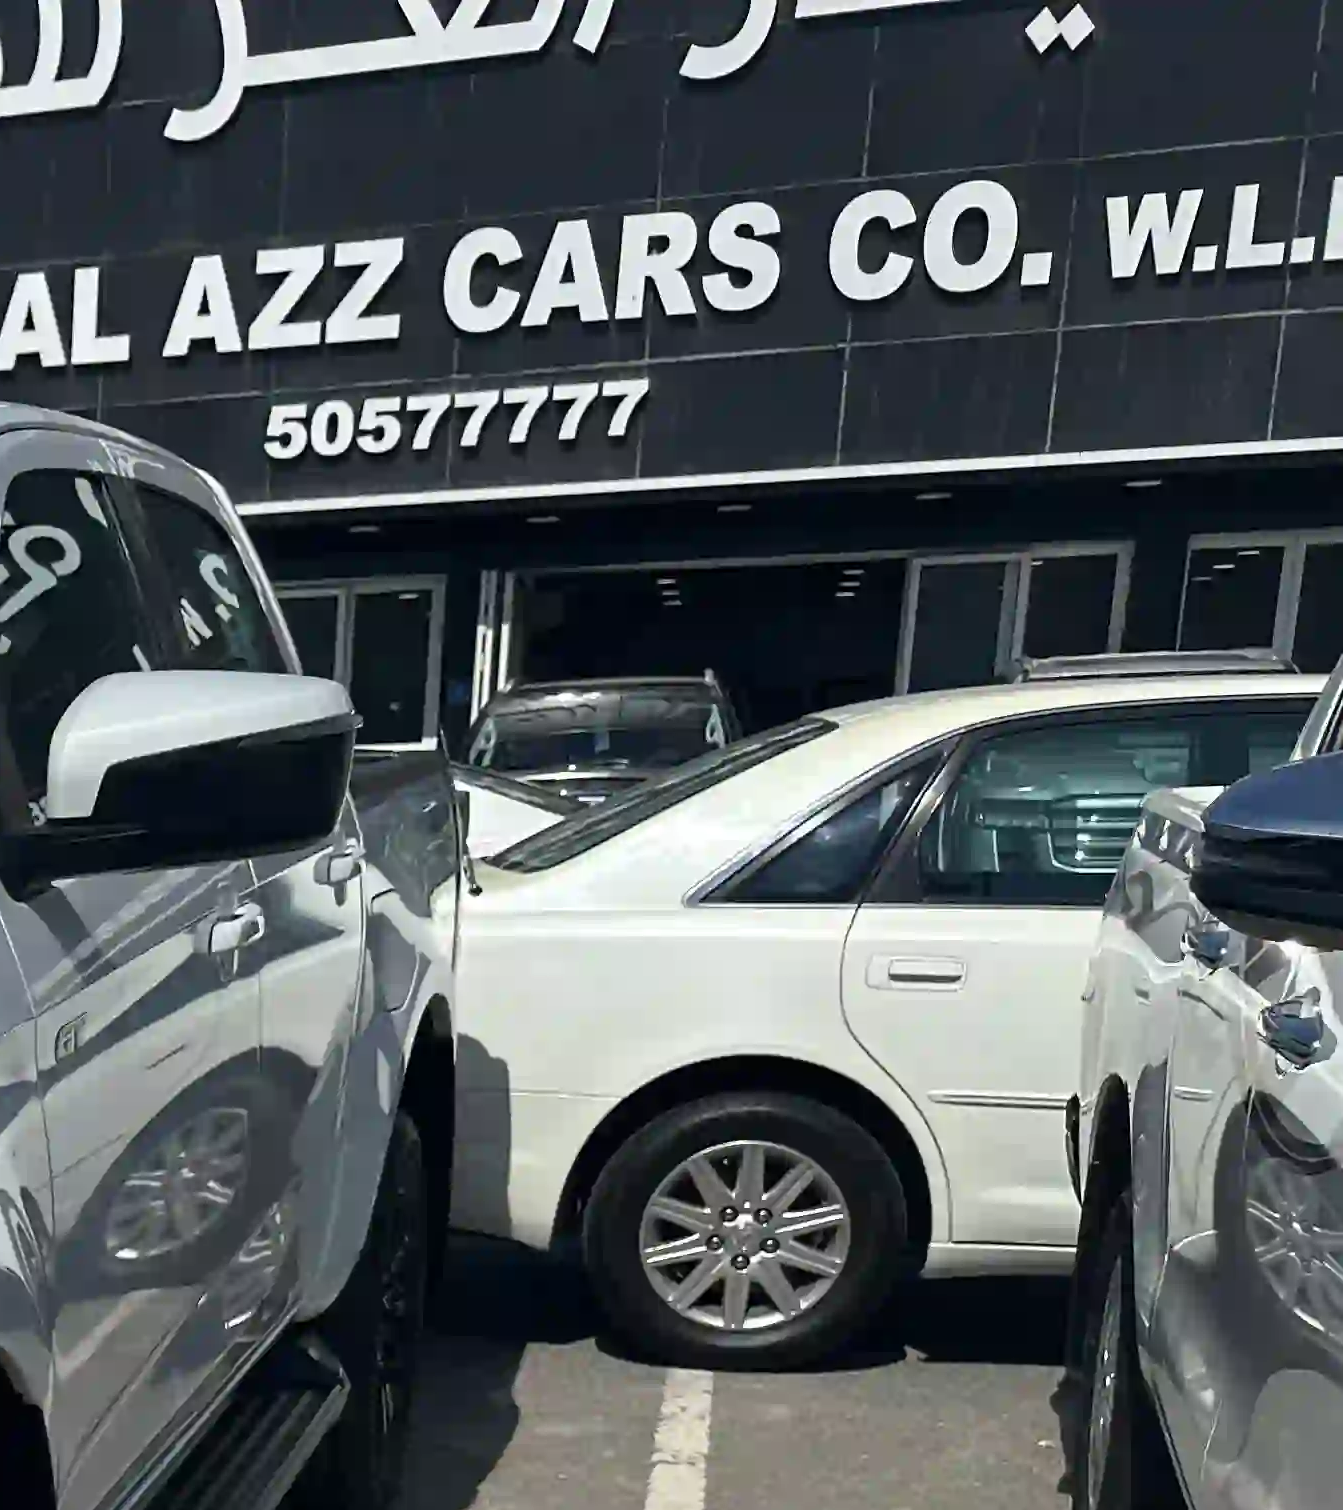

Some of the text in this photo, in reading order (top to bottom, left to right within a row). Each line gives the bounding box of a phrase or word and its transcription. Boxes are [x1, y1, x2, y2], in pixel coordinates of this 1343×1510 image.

[162, 237, 404, 357] AZZ
[443, 201, 781, 333] CARS
[829, 179, 1053, 301] CO.
[263, 377, 650, 459] 50577777
